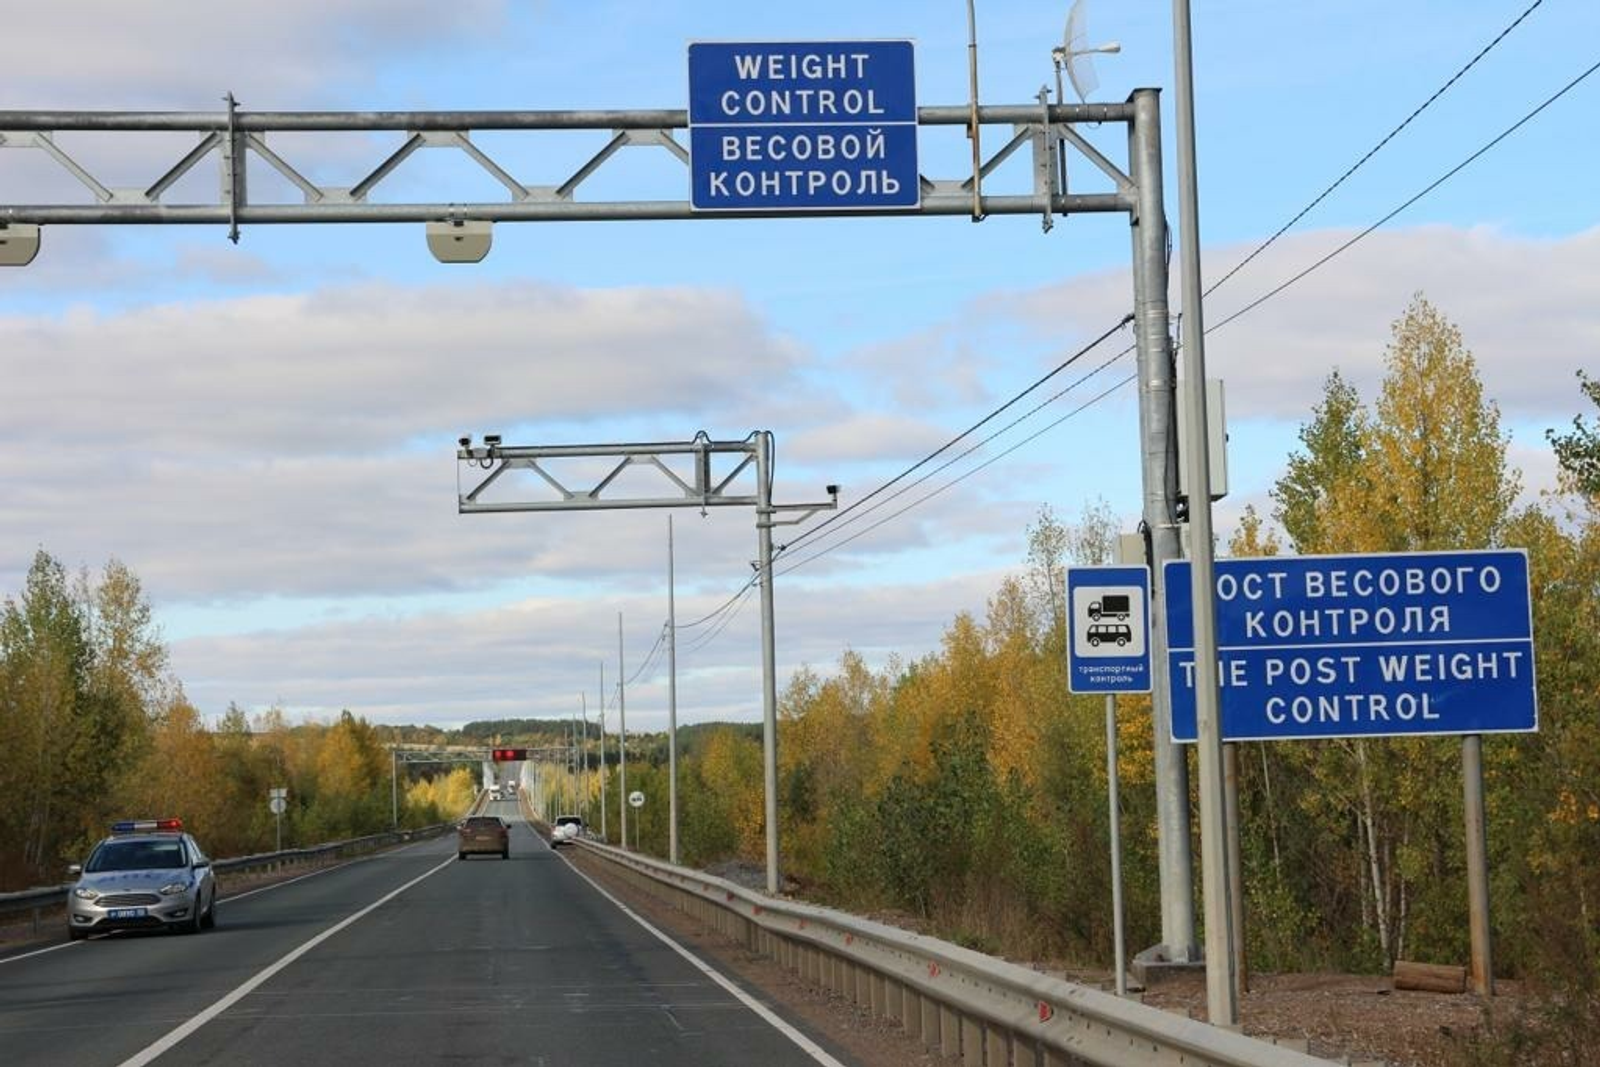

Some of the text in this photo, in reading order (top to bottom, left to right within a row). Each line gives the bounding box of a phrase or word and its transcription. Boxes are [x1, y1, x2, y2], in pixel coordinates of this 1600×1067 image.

[734, 54, 869, 80] WEIGHT
[721, 89, 885, 116] CONTROL
[722, 128, 885, 161] ВЕСОВОЙ
[710, 170, 900, 197] КОНТРОЛЬ
[1215, 566, 1501, 601] ОСТ ВЕСОВОГО
[1245, 605, 1450, 638] КОНТРОЛЯ
[1078, 664, 1144, 676] транспортный
[1089, 675, 1133, 684] контроль
[1265, 656, 1361, 686] POST
[1378, 652, 1523, 682] WEIGHT
[1266, 692, 1440, 724] CONTROL
